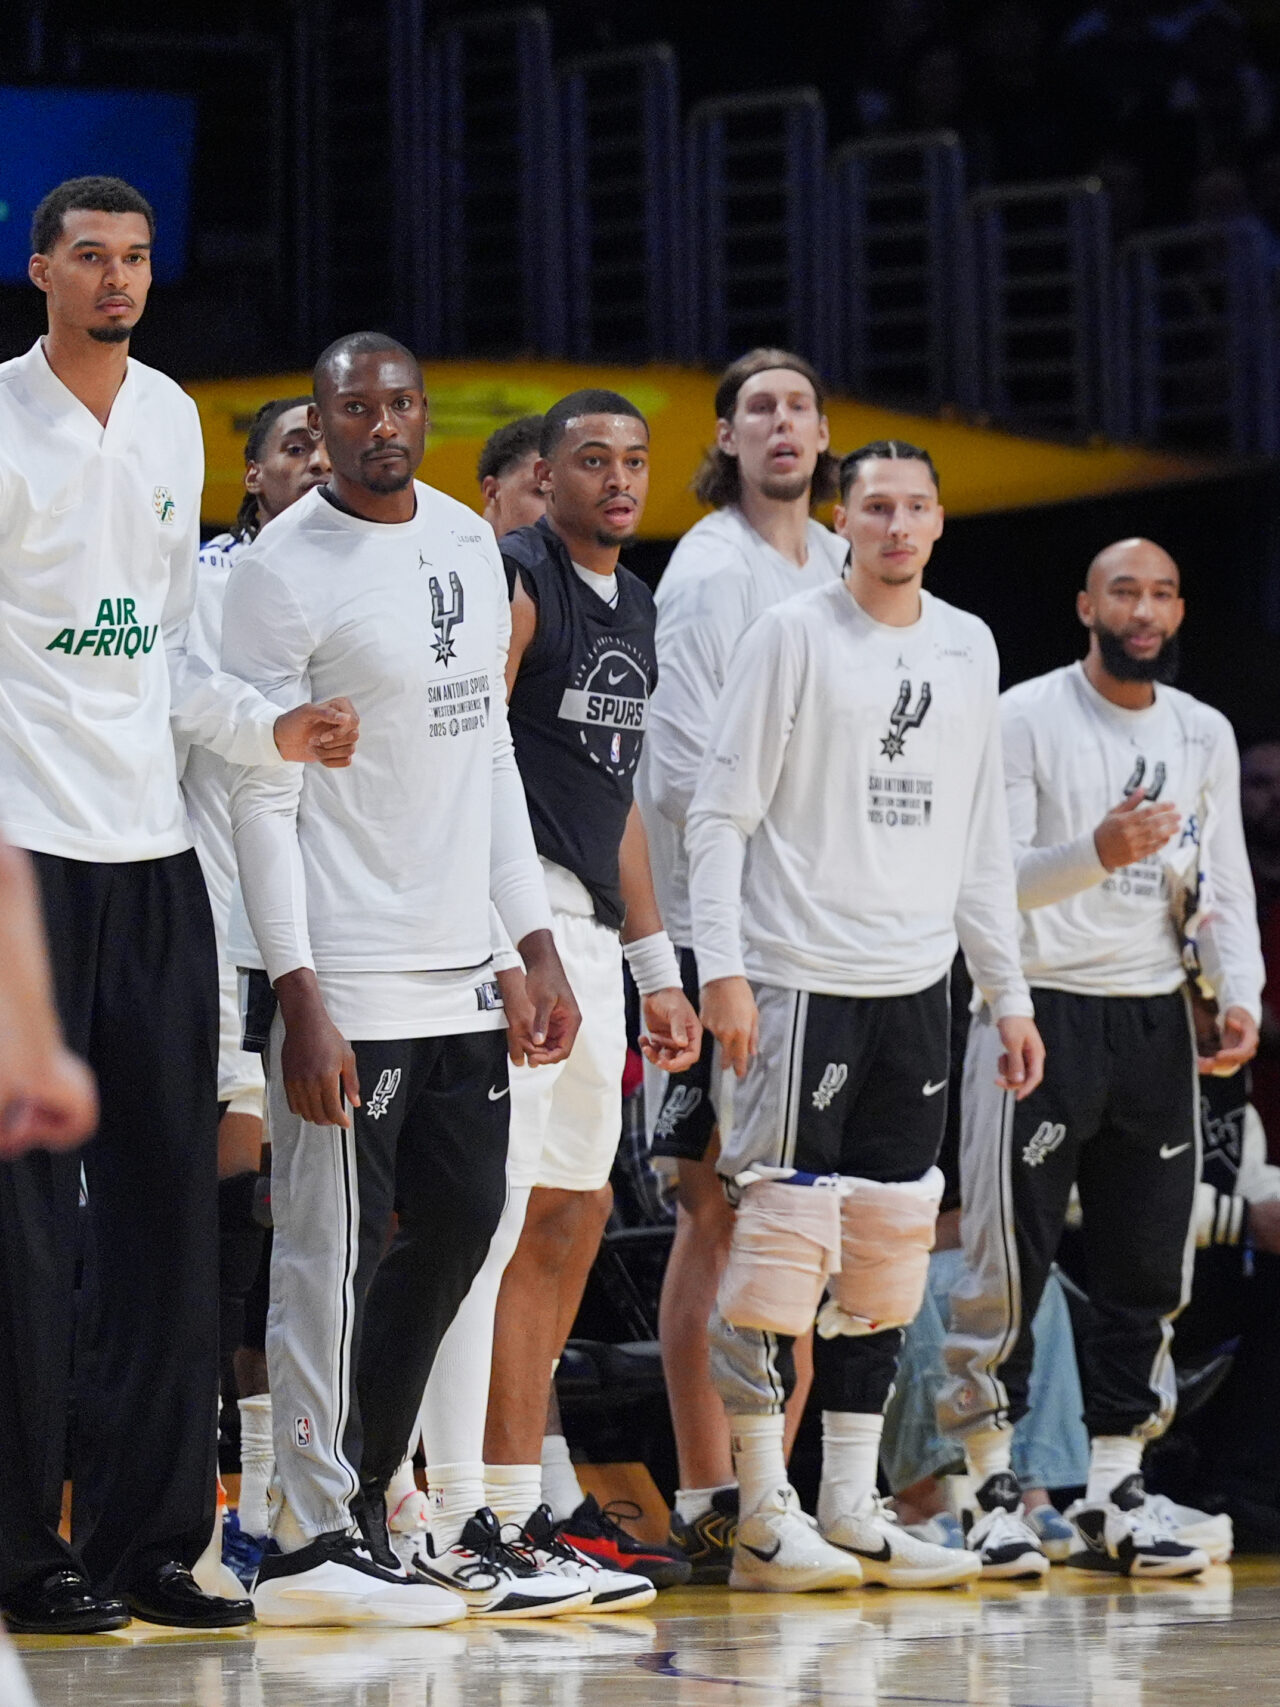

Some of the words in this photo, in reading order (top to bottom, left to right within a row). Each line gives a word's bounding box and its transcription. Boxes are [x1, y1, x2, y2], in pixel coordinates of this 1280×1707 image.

[95, 598, 138, 627] AIR
[428, 685, 442, 703] SAN
[443, 680, 469, 701] ANTONIO
[470, 675, 489, 695] SPURS
[433, 704, 457, 719] WESTERN
[586, 695, 644, 727] SPURS
[429, 722, 447, 738] 2025
[479, 714, 485, 728] C
